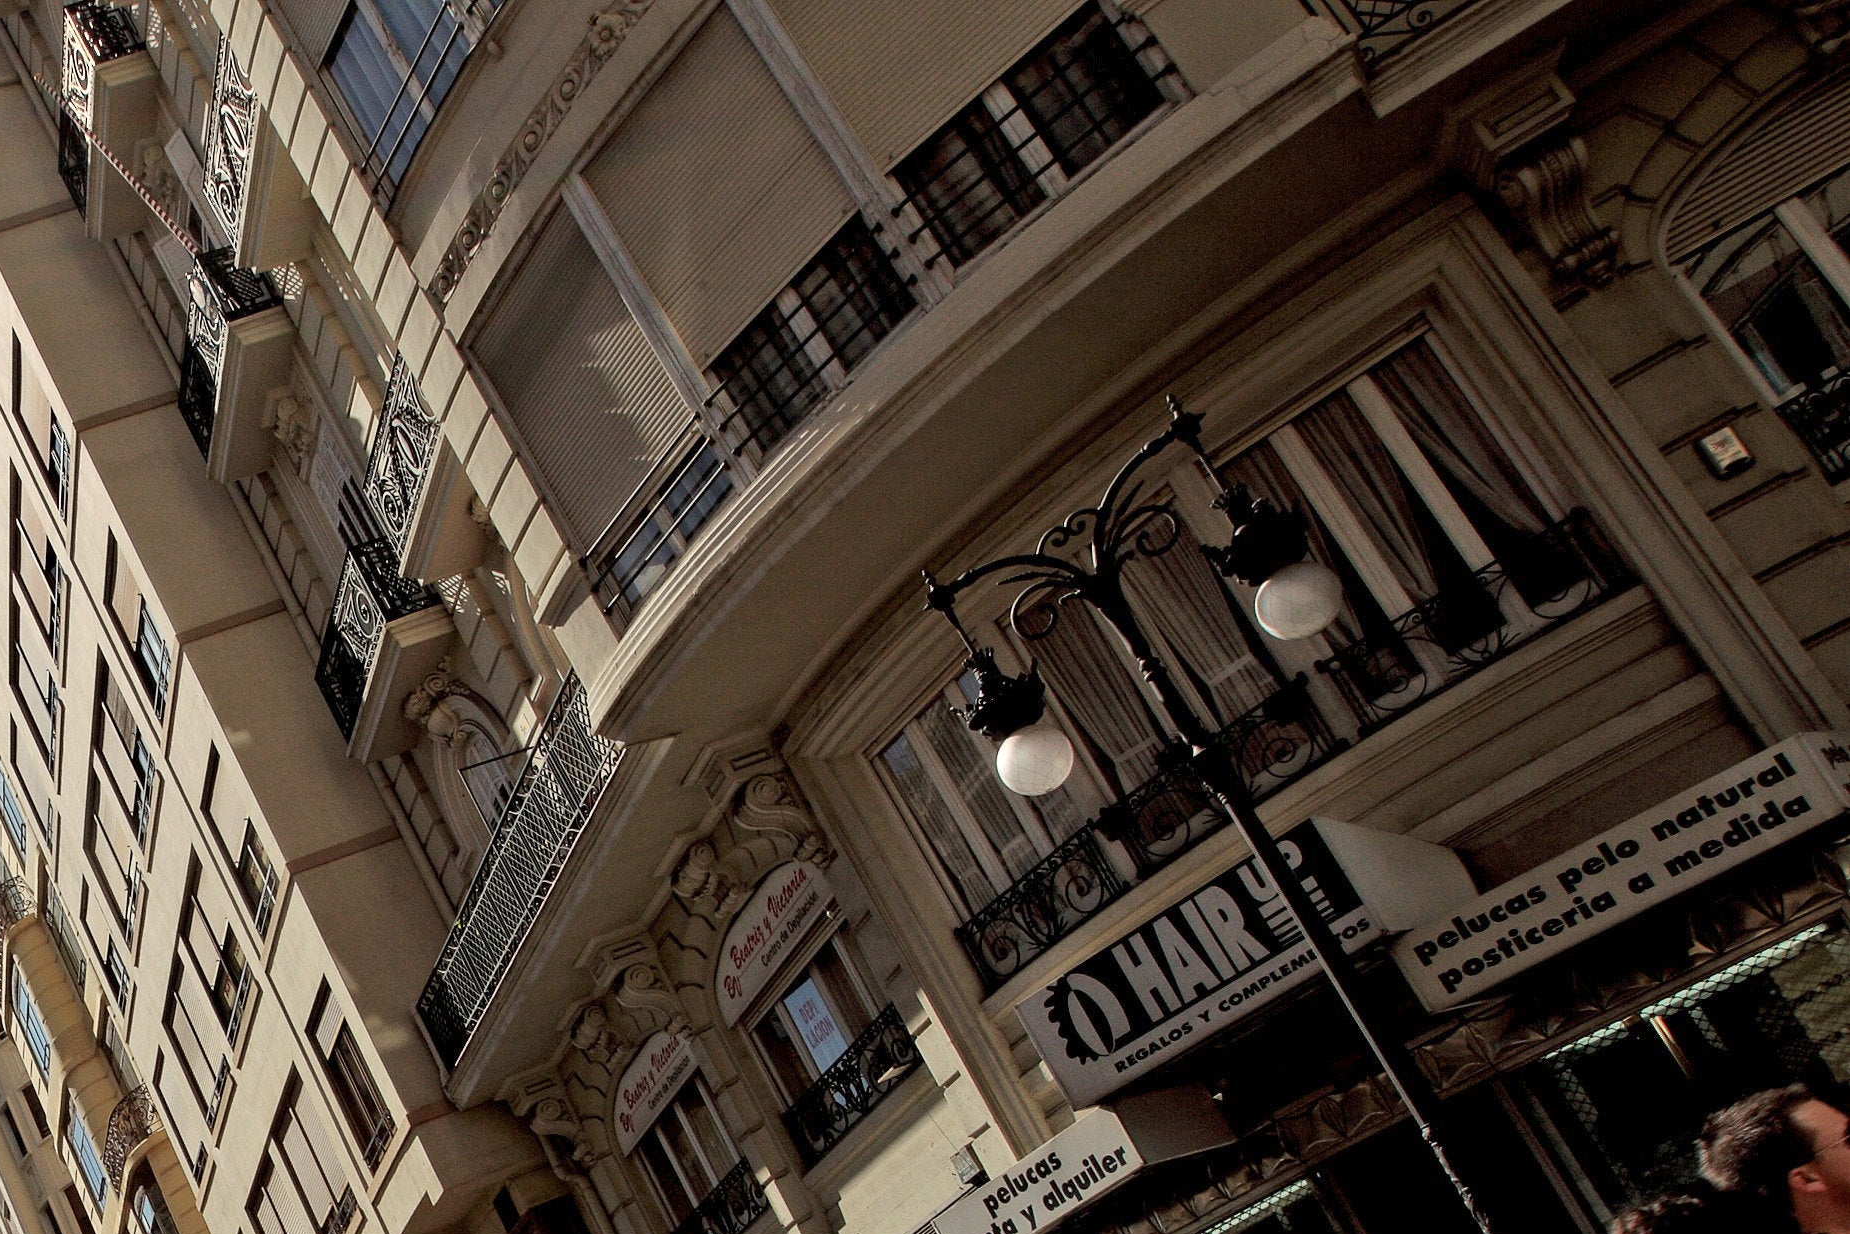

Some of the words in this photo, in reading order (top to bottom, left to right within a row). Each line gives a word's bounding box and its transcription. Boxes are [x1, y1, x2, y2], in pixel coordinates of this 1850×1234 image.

[766, 867, 807, 919] Victoria
[1412, 883, 1548, 967] pelucas
[1555, 838, 1640, 895] pelo
[1649, 752, 1797, 842] natural
[1437, 889, 1618, 995] posticeria
[1627, 871, 1656, 895] a
[1663, 793, 1812, 877] medida
[729, 924, 766, 970] Beatriz
[761, 943, 781, 967] Centro
[779, 929, 790, 944] de
[763, 915, 773, 935] y
[1110, 885, 1271, 1023] HAIR
[1113, 1021, 1194, 1074] REGALOS
[1197, 1008, 1214, 1023] Y
[1217, 917, 1372, 1013] COMPLEMEOS
[982, 1151, 1063, 1220] pelucas
[1019, 1204, 1037, 1232] y
[1042, 1146, 1128, 1212] alquiler
